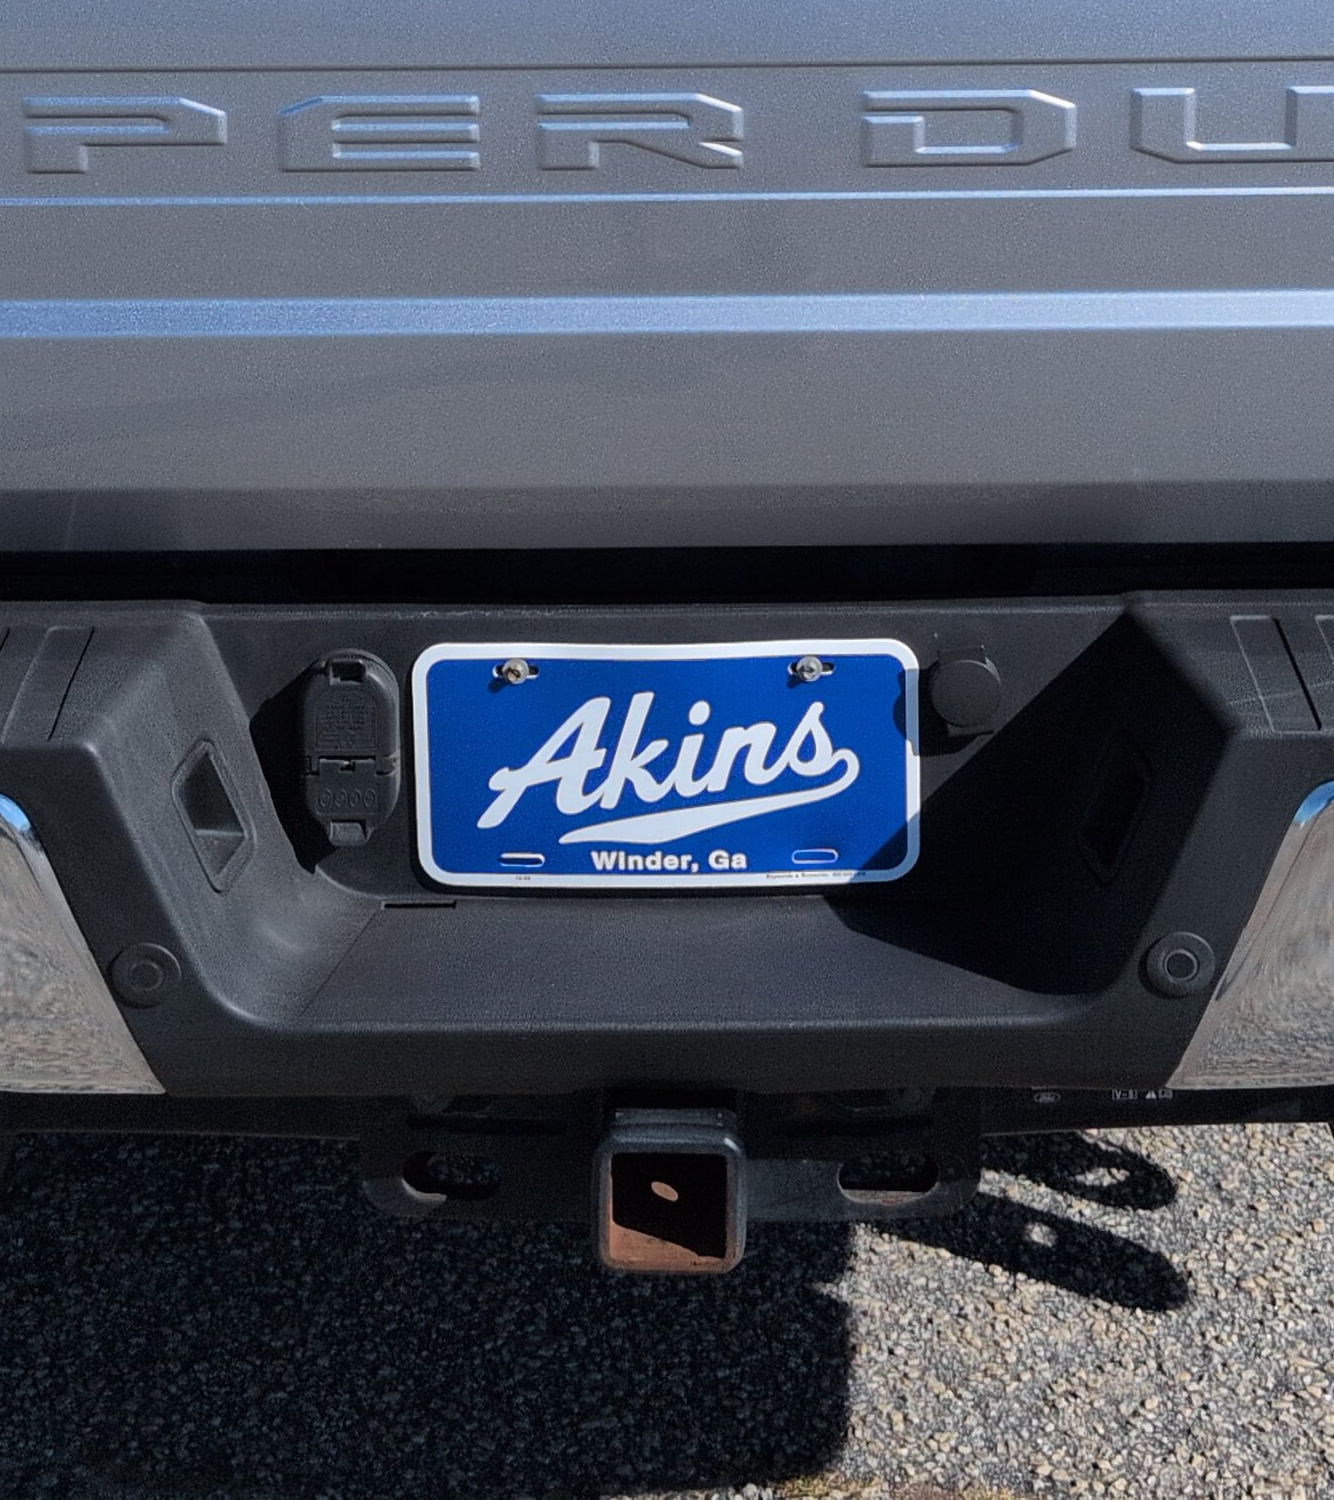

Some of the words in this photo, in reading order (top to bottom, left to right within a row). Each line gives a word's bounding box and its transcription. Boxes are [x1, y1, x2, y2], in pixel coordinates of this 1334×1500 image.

[476, 690, 860, 830] Akins
[590, 850, 700, 873] Winder,
[708, 849, 748, 870] Ga
